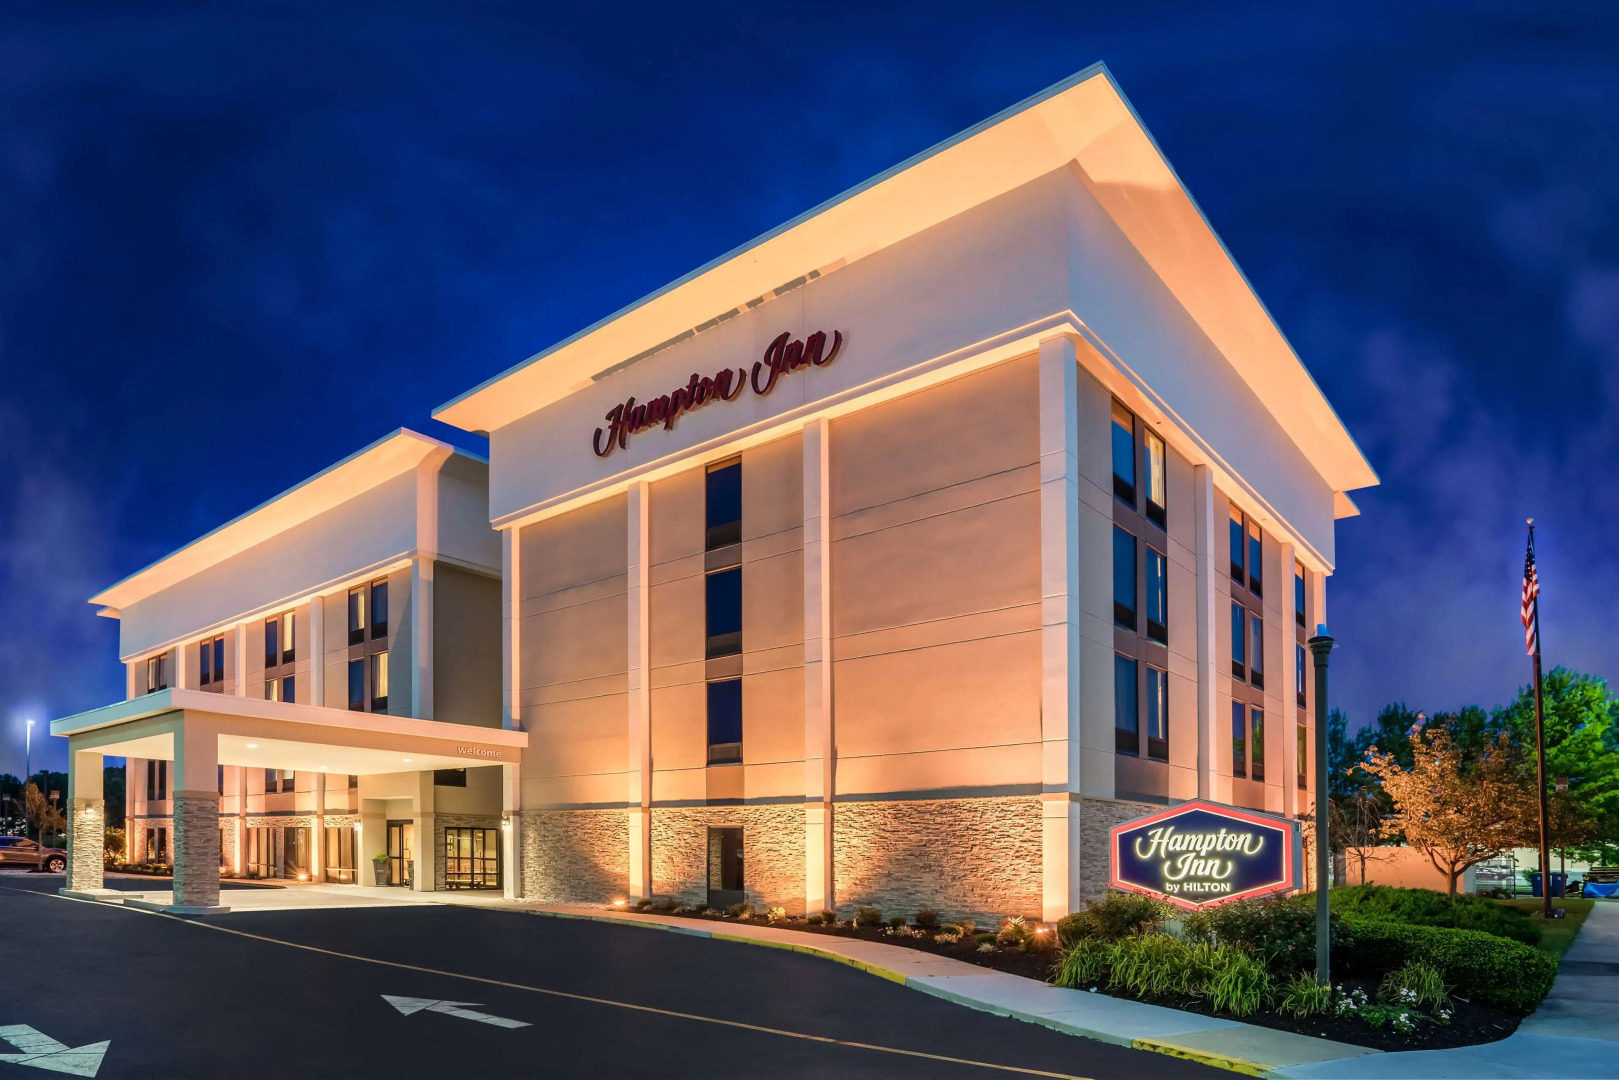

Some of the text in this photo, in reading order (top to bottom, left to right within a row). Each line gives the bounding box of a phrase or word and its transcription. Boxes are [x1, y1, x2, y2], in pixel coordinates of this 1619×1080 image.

[593, 330, 843, 457] Hampton Inn
[458, 746, 502, 757] welcome
[1135, 826, 1263, 858] Hampton
[1164, 853, 1232, 880] Inn
[1166, 883, 1231, 892] by HILTON
